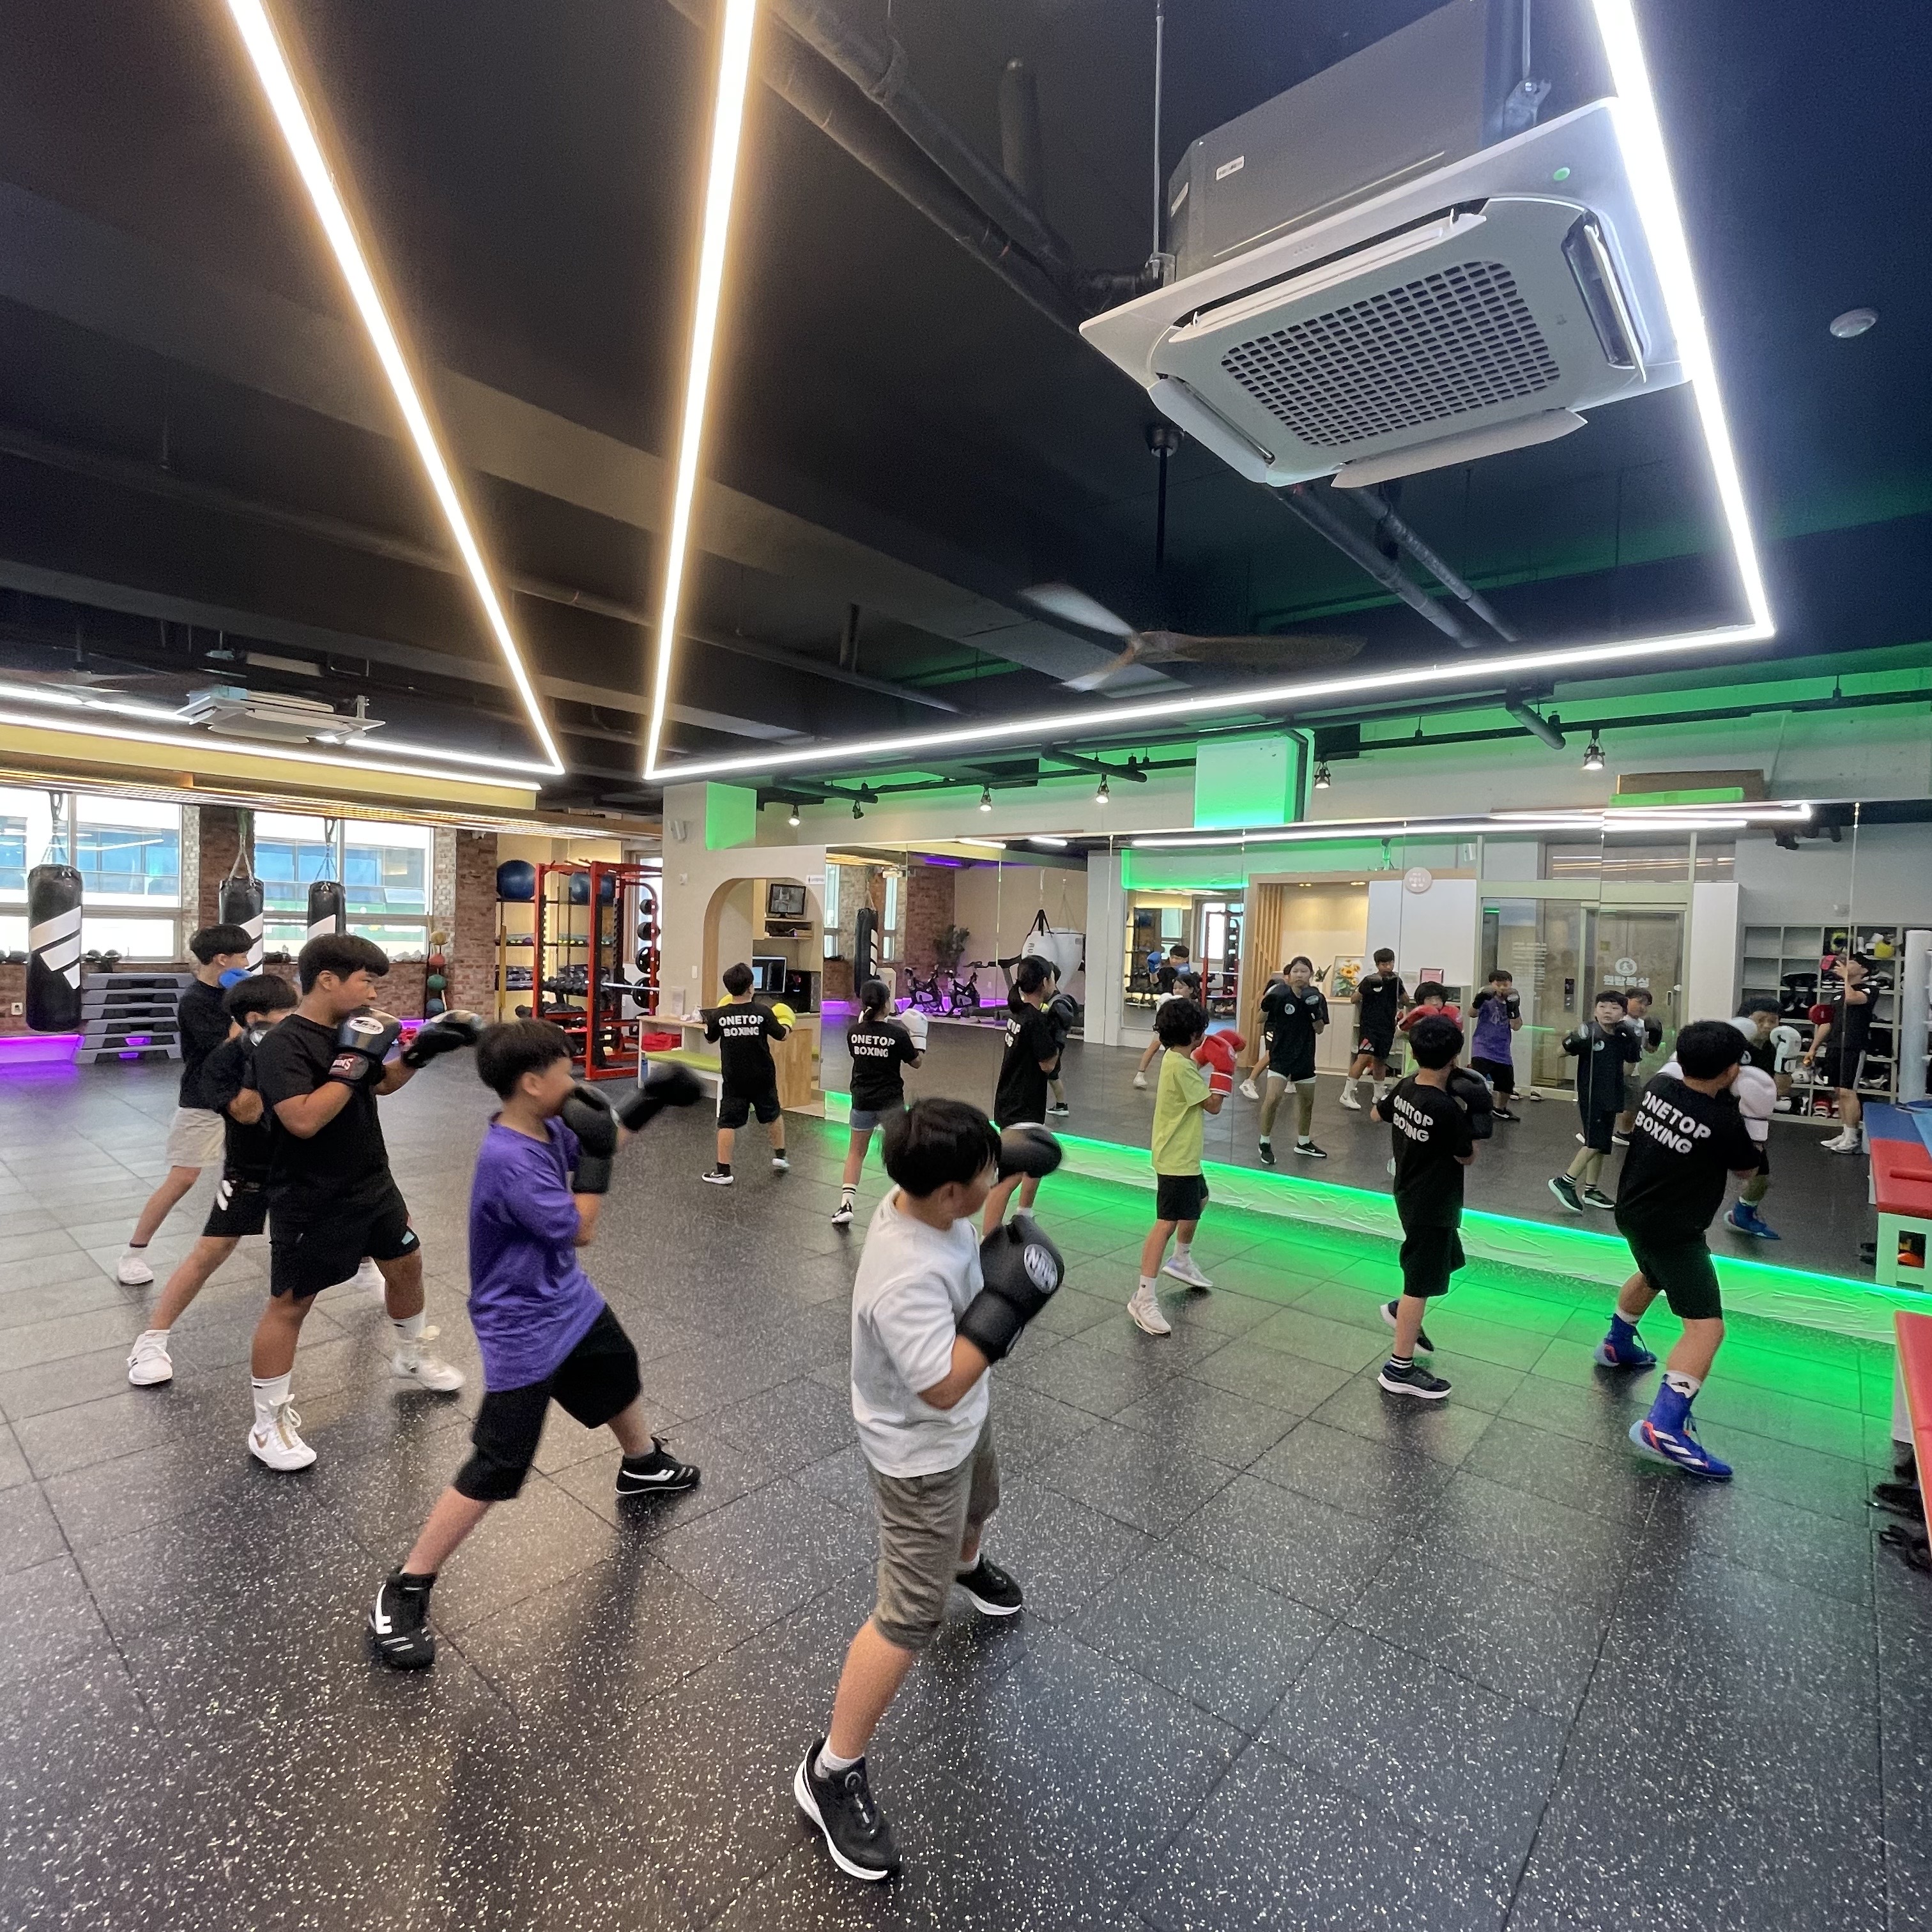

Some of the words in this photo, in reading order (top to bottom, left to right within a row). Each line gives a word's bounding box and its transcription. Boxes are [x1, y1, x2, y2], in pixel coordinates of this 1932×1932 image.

[719, 1015, 764, 1027] ONETOP
[723, 1026, 759, 1037] BOXING
[851, 1034, 895, 1046] ONETOP
[854, 1046, 889, 1057] BOXING
[1635, 1110, 1692, 1154] BOXING
